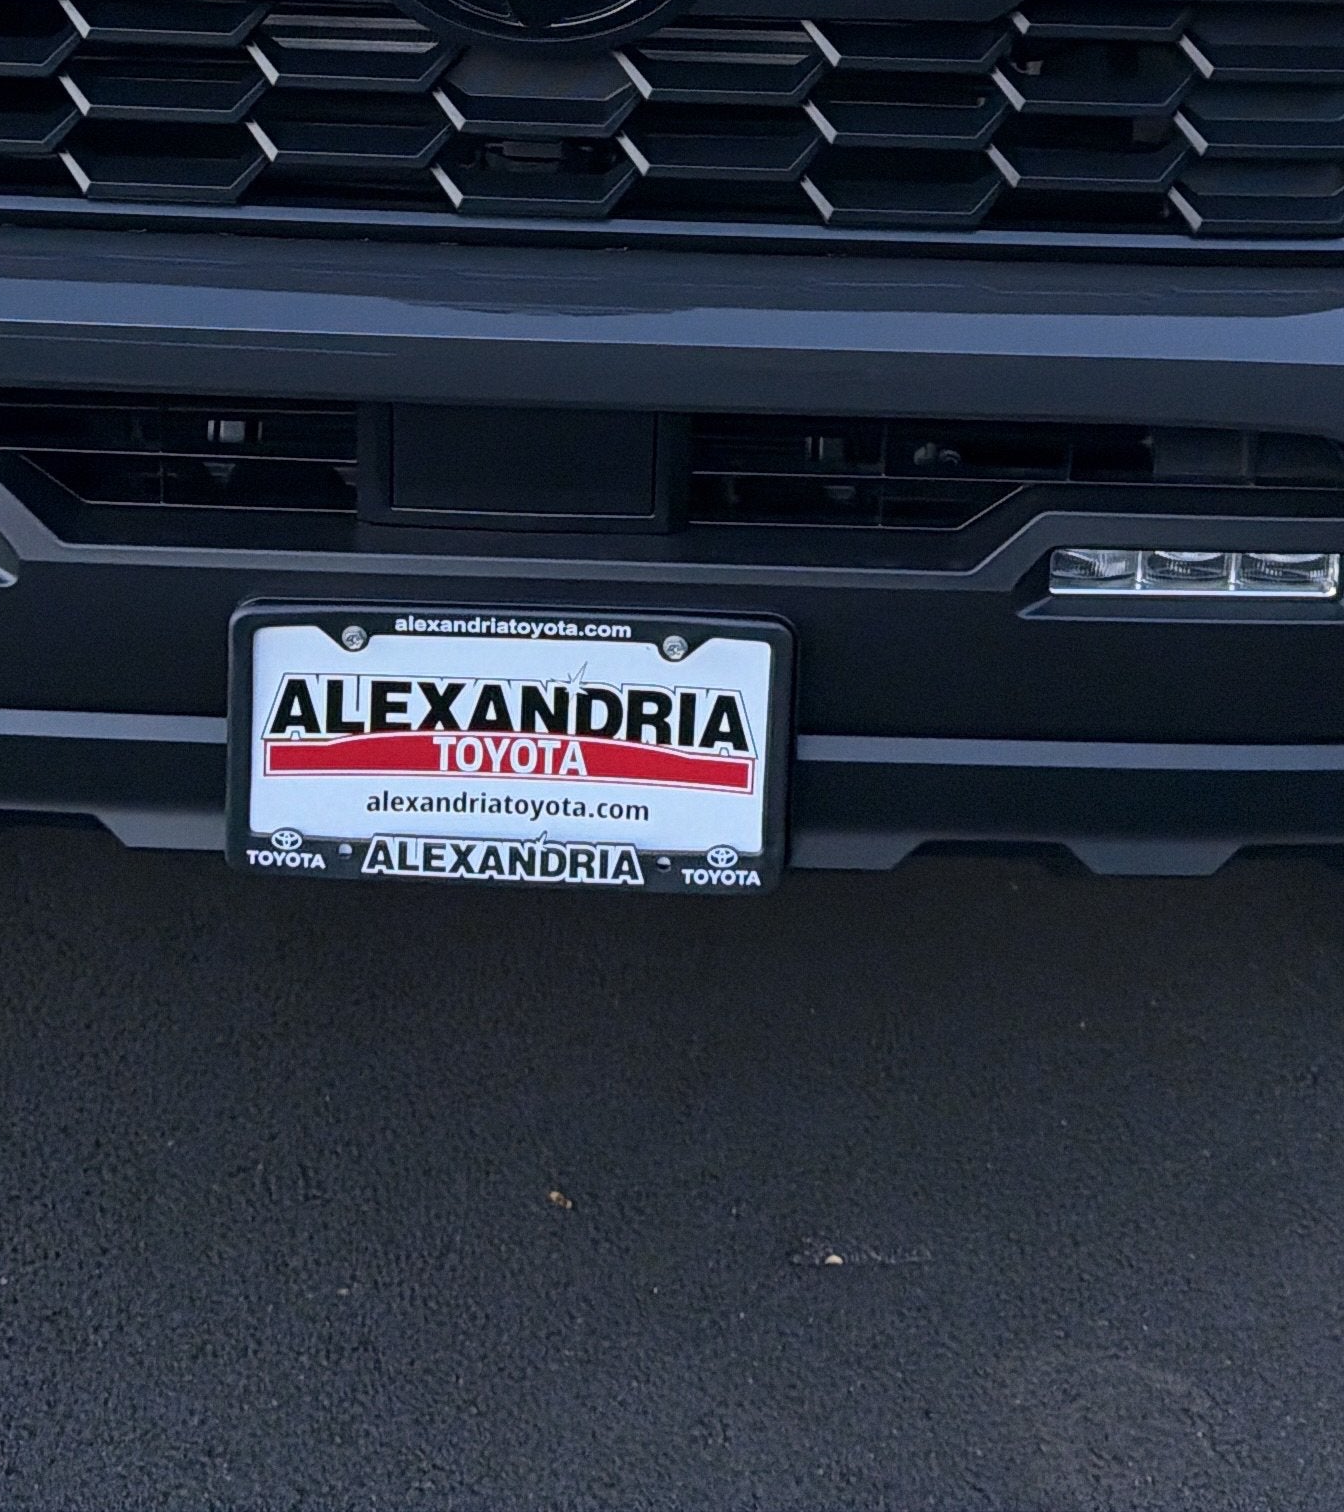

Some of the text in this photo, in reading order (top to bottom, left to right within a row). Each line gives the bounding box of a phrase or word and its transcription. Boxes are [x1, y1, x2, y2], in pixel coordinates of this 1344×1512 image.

[394, 615, 632, 639] alexandriatoyota.com
[268, 677, 751, 752] ALEXANDRIA
[432, 736, 588, 776] TOYOTA
[366, 789, 649, 822] alexandriatoyota.com
[245, 848, 327, 870] TOYOTA
[362, 836, 644, 884] ALEXANDRIA
[680, 868, 762, 887] TOYOTA
